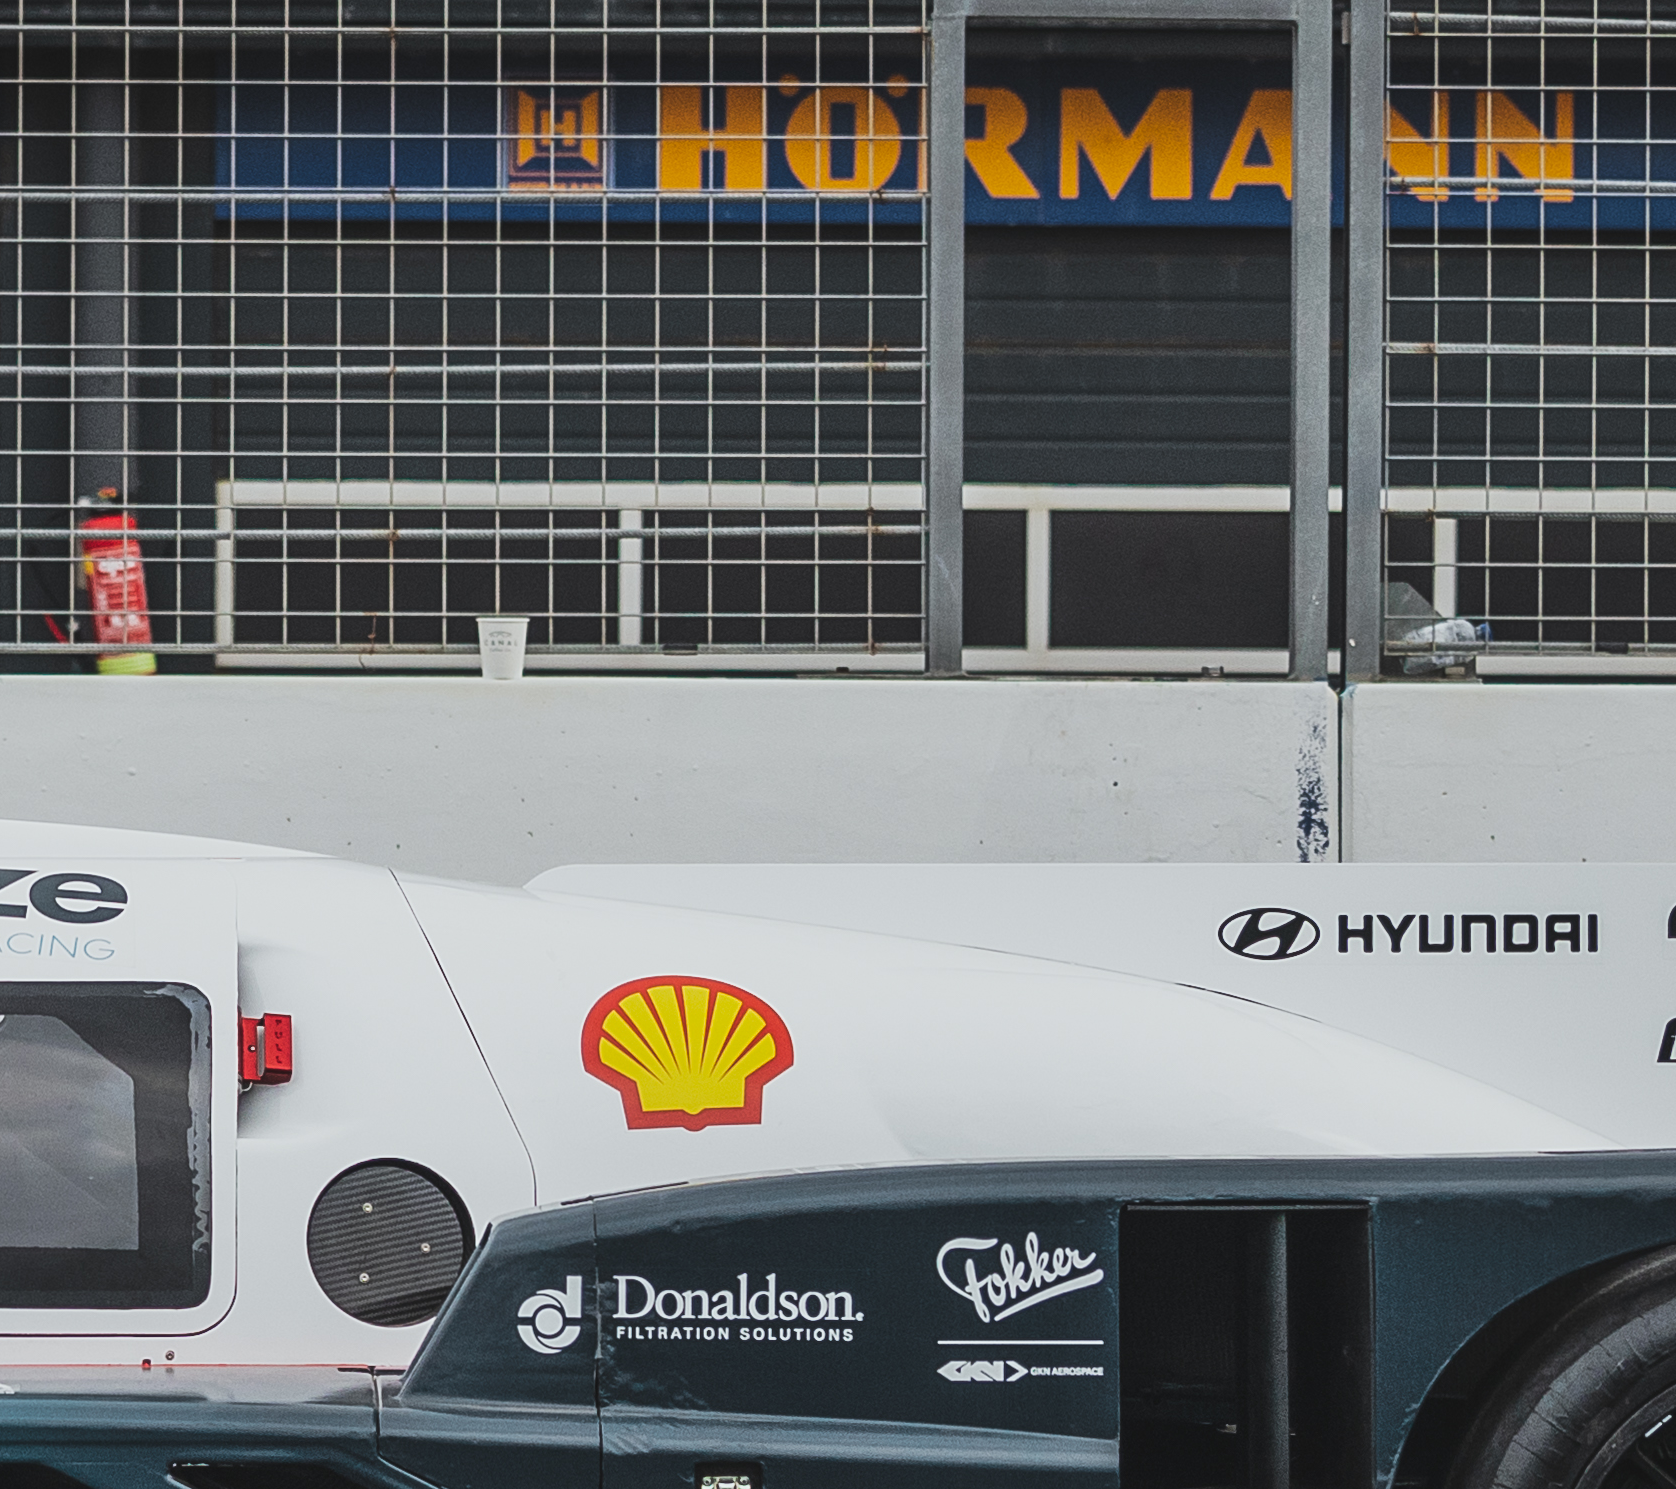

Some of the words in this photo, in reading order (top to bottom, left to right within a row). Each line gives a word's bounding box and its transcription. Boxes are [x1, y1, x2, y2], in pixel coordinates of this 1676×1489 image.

[1337, 914, 1599, 955] HYUNDAI
[936, 1231, 1097, 1324] Fokker
[616, 1326, 730, 1341] FILTRATION
[739, 1326, 854, 1342] SOLUTIONS
[1030, 1366, 1050, 1377] GKN
[1051, 1366, 1104, 1377] AEROSPACE
